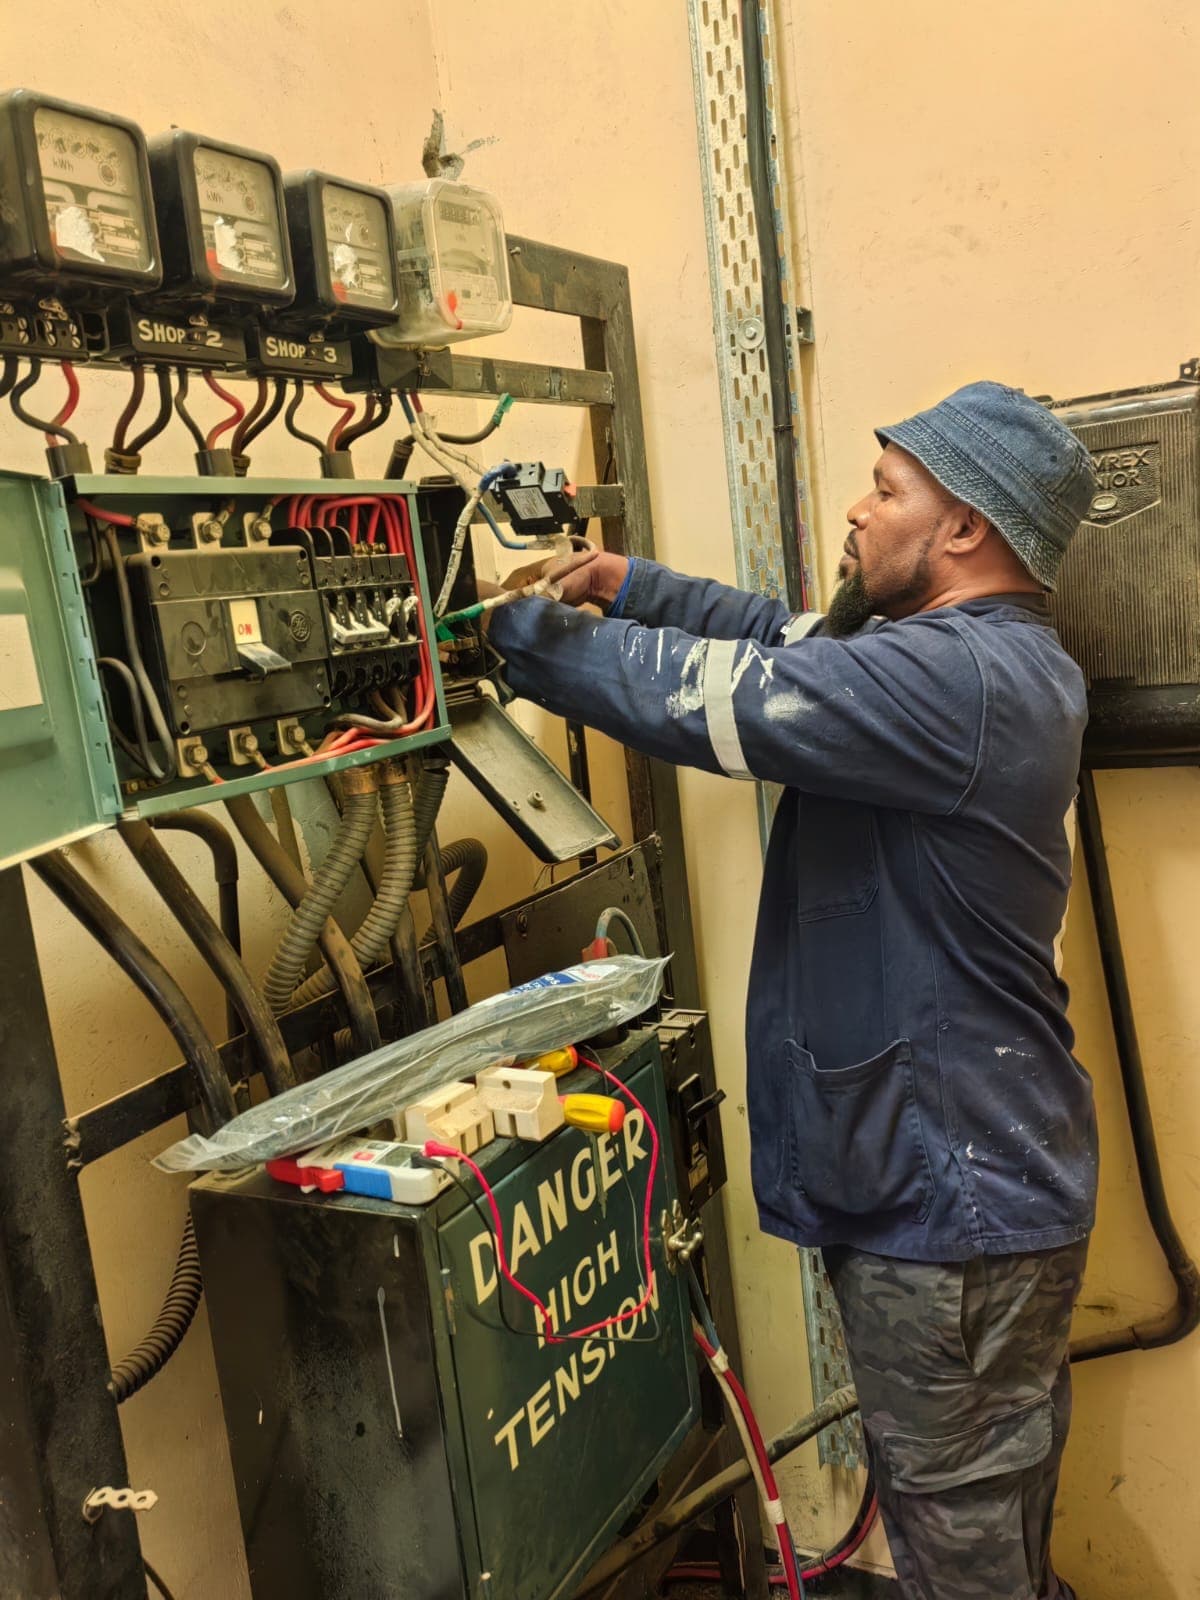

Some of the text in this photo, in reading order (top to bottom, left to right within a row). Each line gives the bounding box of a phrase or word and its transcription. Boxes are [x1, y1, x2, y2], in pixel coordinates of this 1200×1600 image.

[137, 318, 224, 348] SHOP 2
[265, 336, 338, 364] SHOP 3
[237, 623, 253, 636] ON
[468, 1107, 649, 1306] DANGER
[533, 1229, 622, 1350] HIGH
[493, 1269, 660, 1472] TENSION
